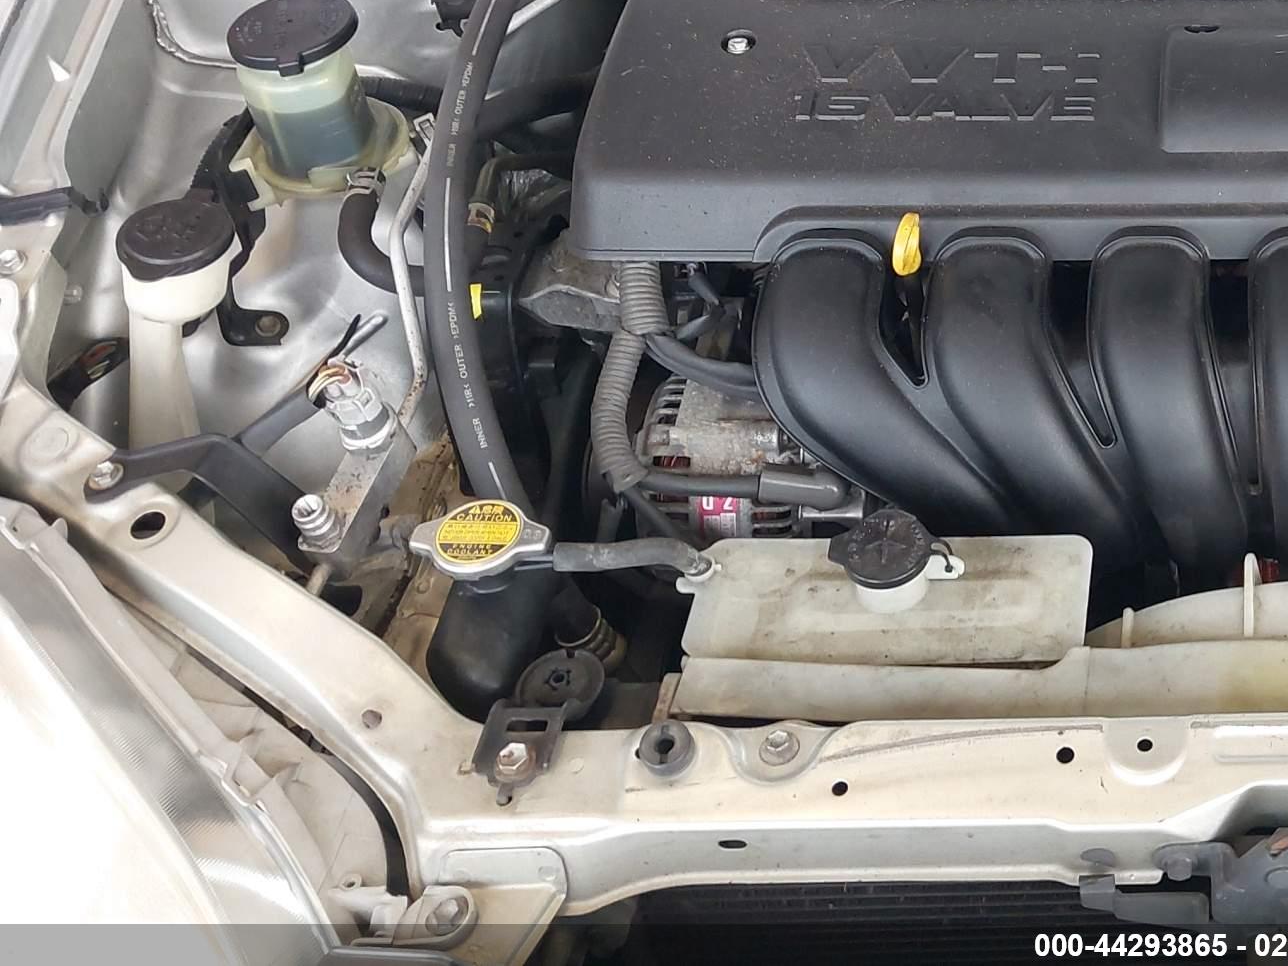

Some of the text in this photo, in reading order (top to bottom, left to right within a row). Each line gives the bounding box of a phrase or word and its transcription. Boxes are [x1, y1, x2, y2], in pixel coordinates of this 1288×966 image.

[454, 344, 468, 379] OUTER
[472, 417, 489, 449] INNER
[456, 513, 512, 522] CAUTION
